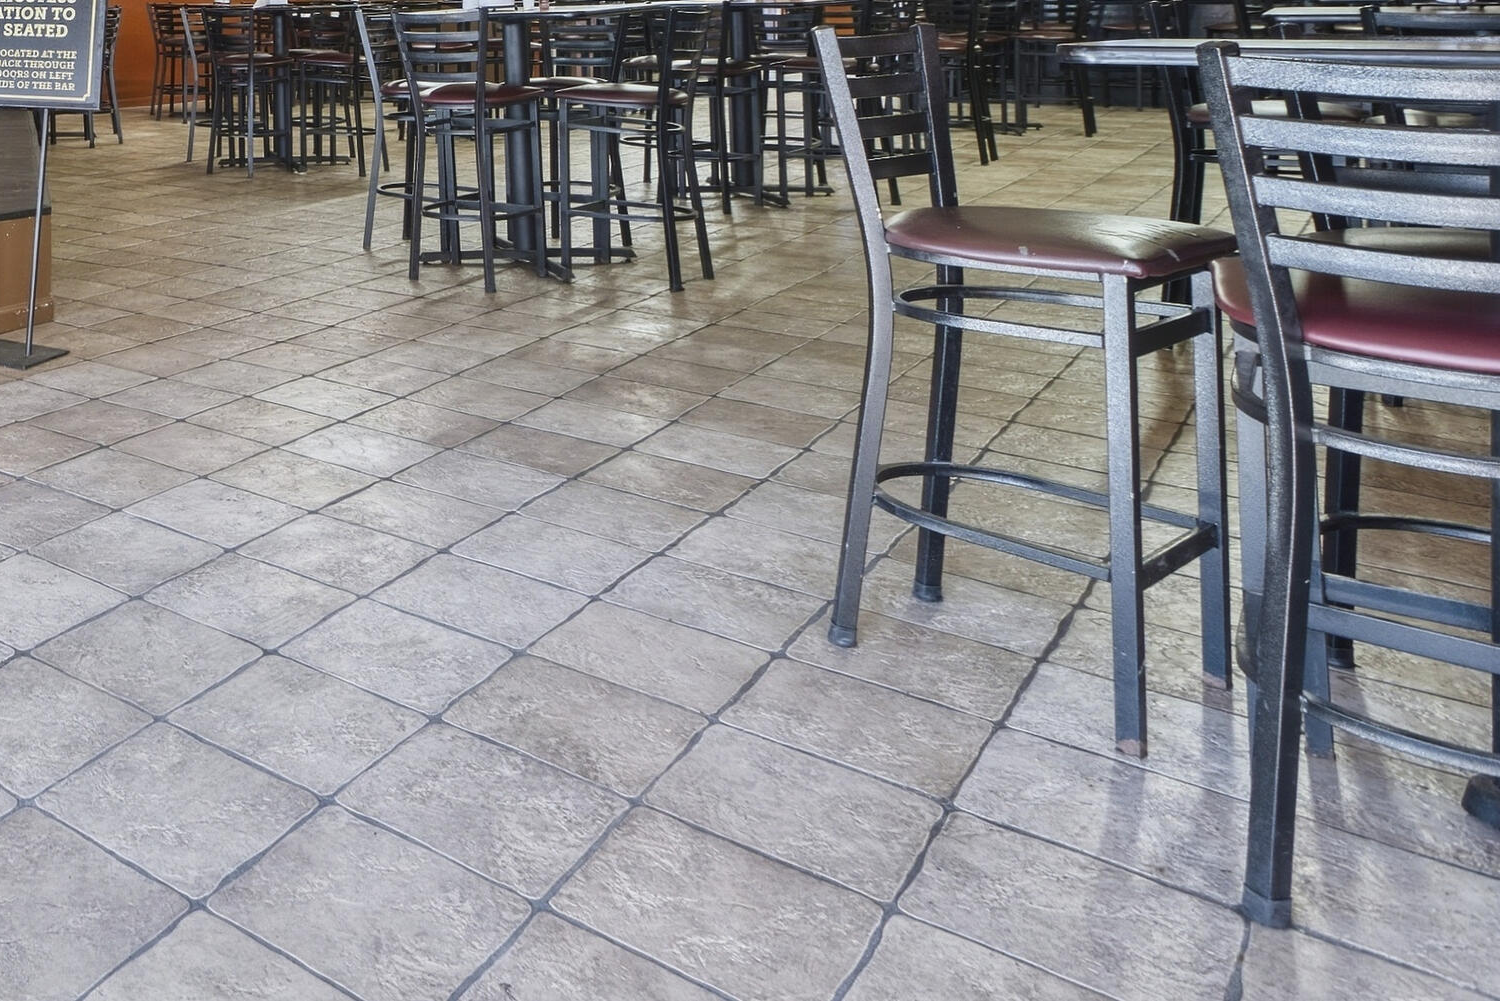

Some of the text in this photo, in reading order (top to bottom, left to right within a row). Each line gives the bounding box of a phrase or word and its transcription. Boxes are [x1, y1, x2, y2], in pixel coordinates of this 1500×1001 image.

[52, 7, 76, 21] TO
[3, 23, 68, 38] SEATED
[41, 50, 55, 59] AT
[56, 50, 77, 59] THE
[24, 60, 75, 70] THROUGH
[32, 70, 46, 79] ON
[49, 71, 74, 80] LEFT
[17, 81, 30, 90] OF
[32, 81, 52, 90] THE
[54, 82, 76, 92] BAR
